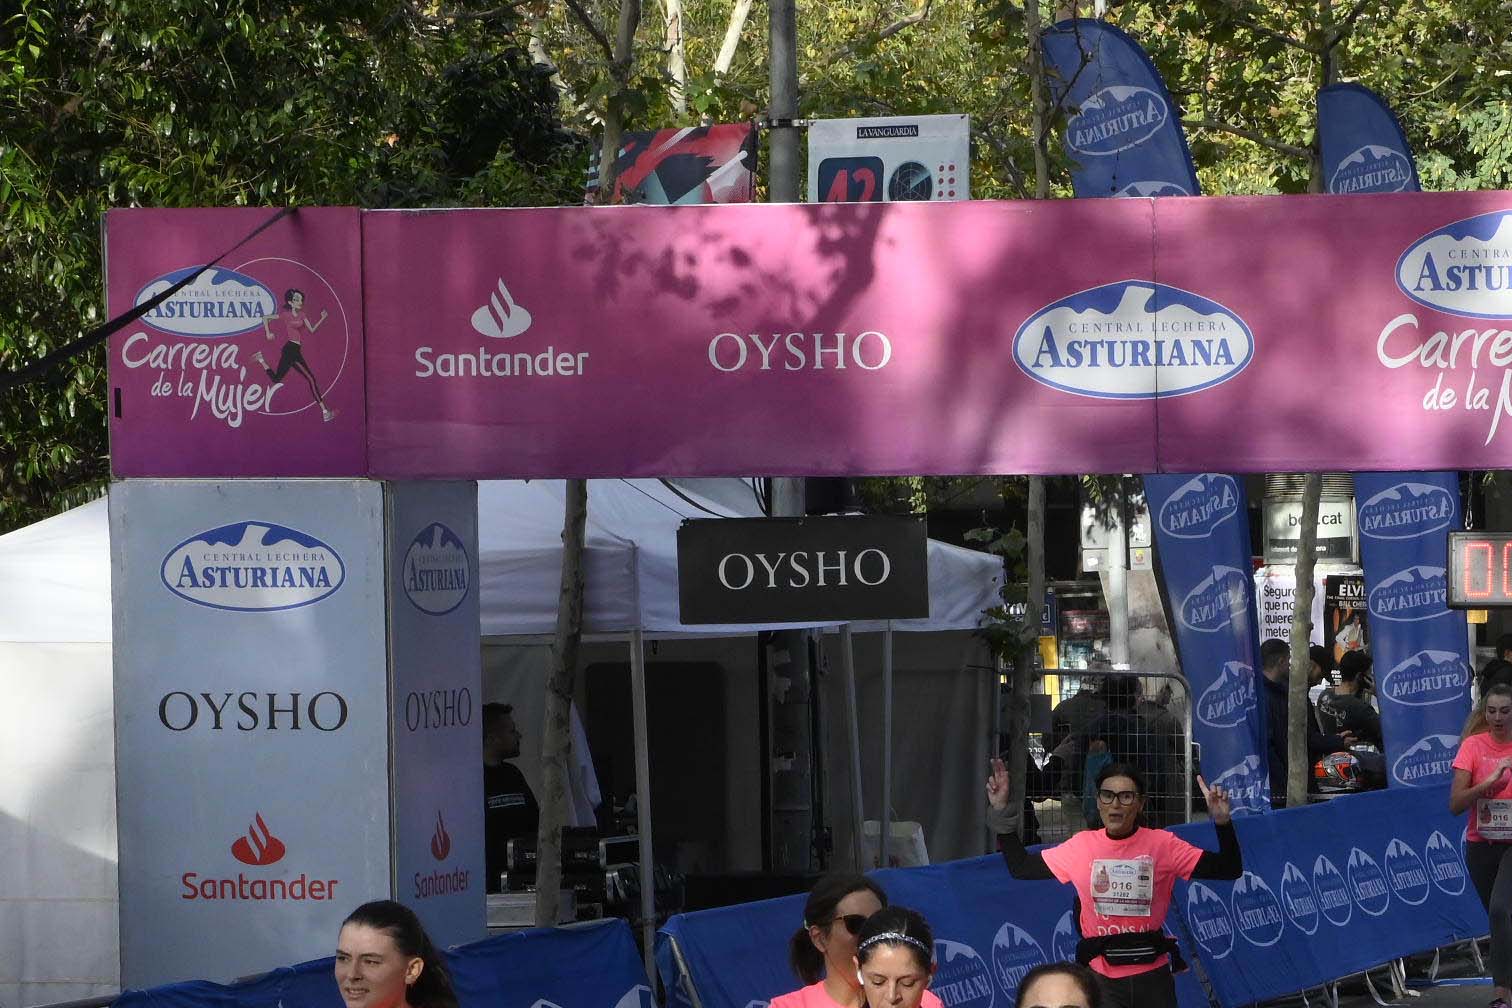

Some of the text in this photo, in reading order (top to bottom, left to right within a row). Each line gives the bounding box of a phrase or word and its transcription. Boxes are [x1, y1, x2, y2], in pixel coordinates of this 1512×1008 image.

[145, 291, 265, 319] ASTURIANA
[171, 290, 211, 298] ENTRAL
[1069, 320, 1228, 333] CENTRAL LECHERA
[121, 332, 240, 369] Carrera
[709, 331, 892, 372] OYSHO
[1031, 324, 1235, 368] ASTURIANA
[415, 346, 589, 378] Santander
[151, 366, 284, 428] de la Mujer
[1423, 371, 1457, 410] de
[1466, 370, 1490, 410] la
[176, 555, 332, 589] ASTURIANA
[203, 552, 325, 562] CENTRAL LECHERA
[718, 548, 891, 591] OYSHO
[407, 562, 466, 593] ASTURIANA
[1339, 585, 1367, 597] ELVI
[1264, 601, 1281, 612] que
[1265, 626, 1290, 637] mete
[158, 691, 348, 731] OYSHO
[405, 687, 472, 731] OYSHO
[181, 872, 338, 901] Santander
[414, 867, 470, 898] Santander
[1112, 882, 1132, 890] 016
